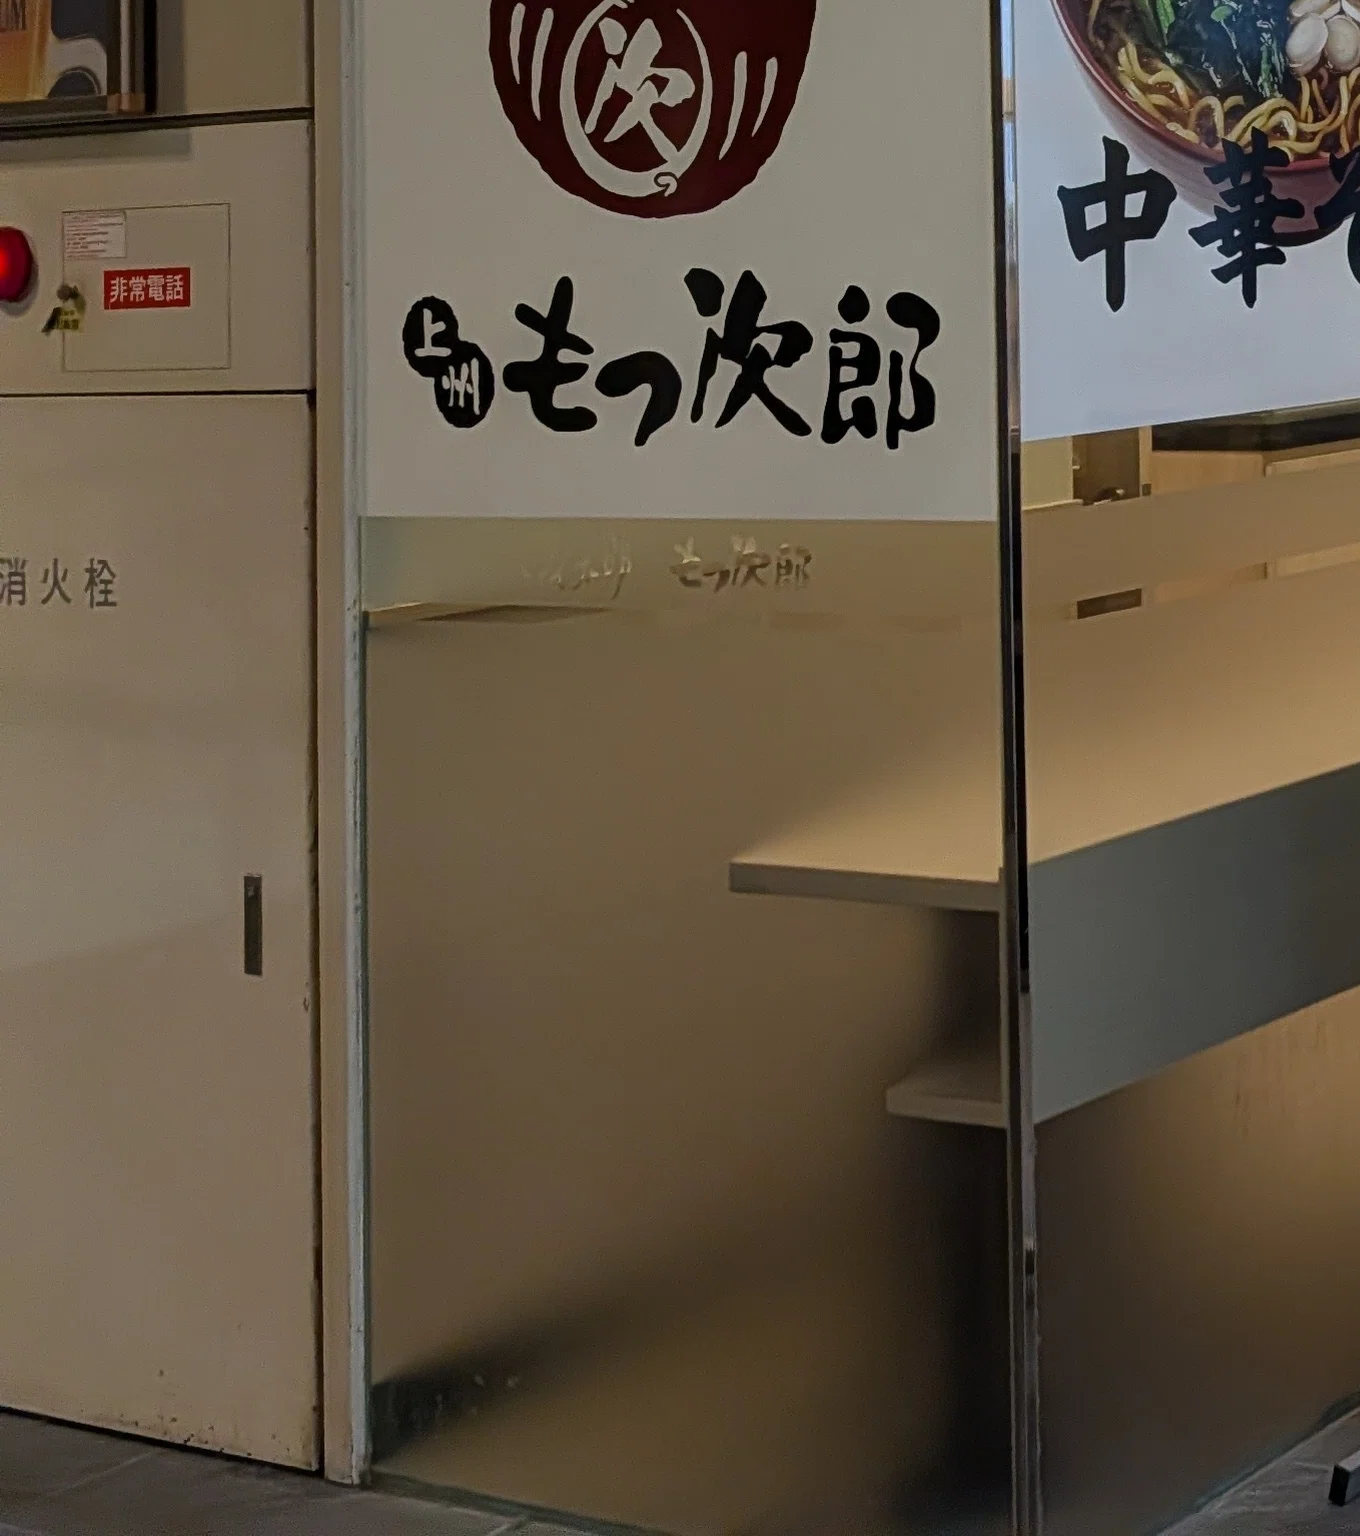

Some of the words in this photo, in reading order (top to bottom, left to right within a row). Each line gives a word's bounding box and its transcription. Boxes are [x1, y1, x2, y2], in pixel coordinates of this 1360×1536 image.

[109, 274, 184, 303] 非常電話
[504, 267, 941, 449] もつ次郎
[0, 557, 118, 609] 消火栓
